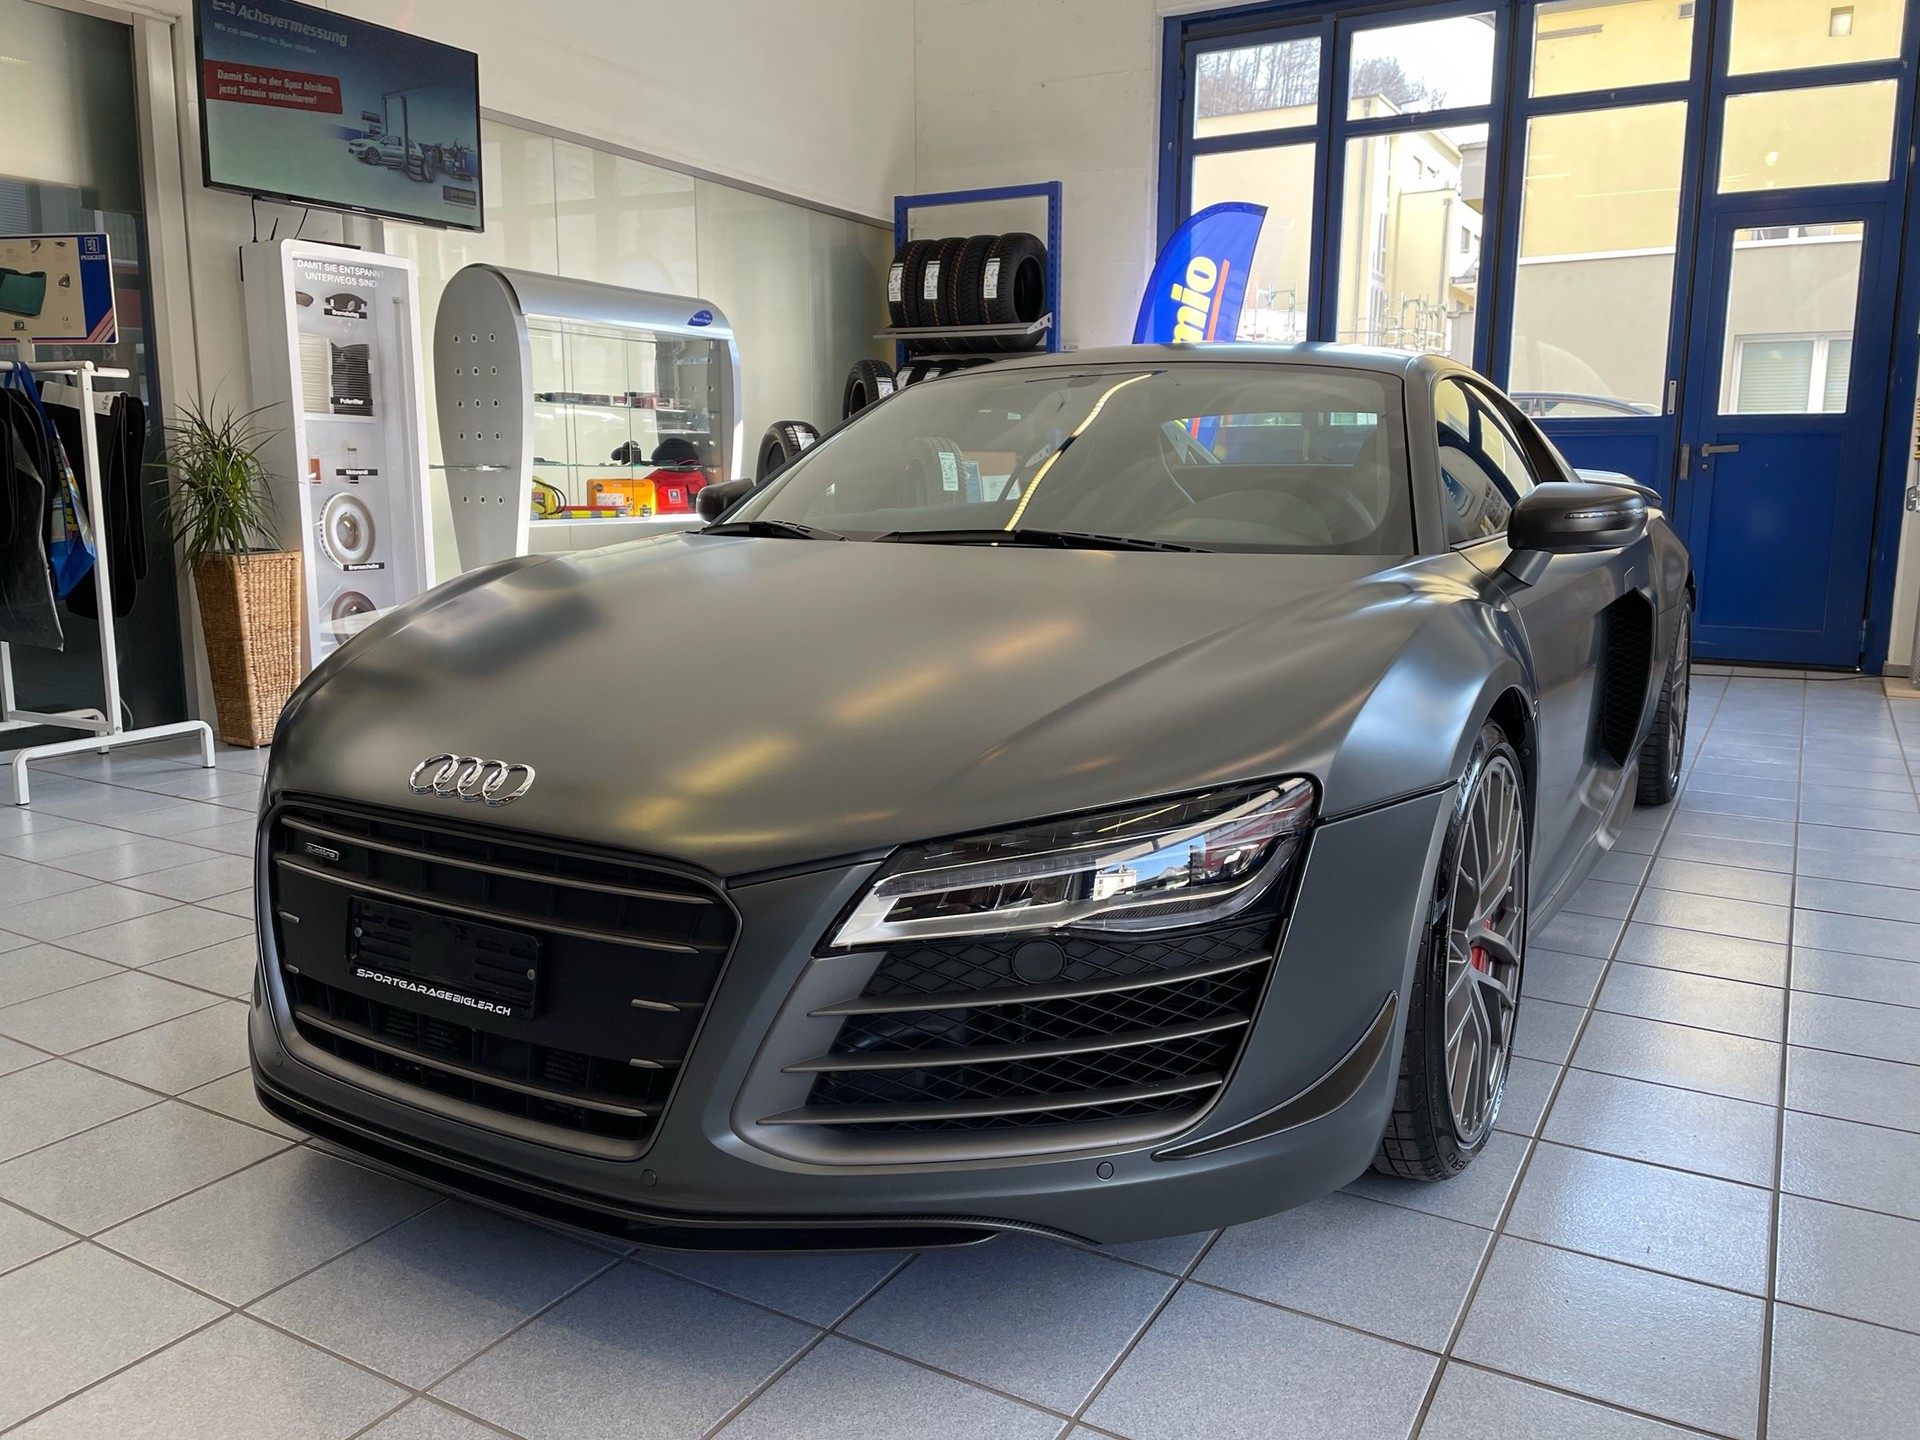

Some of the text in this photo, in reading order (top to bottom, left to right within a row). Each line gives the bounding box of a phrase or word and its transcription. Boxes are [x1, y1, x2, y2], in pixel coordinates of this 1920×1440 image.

[237, 4, 348, 47] Achsvermessung
[217, 69, 334, 95] Damit Sie in der Spur bleiben,
[218, 84, 318, 105] jetzt Termin vereinbaren!
[297, 259, 384, 278] DAMIT SIE ENTSPANNT
[305, 272, 357, 286] UNTERWEGS
[306, 845, 336, 858] quattro
[356, 968, 512, 1017] SPORTGARAGEBIGLER.CH
